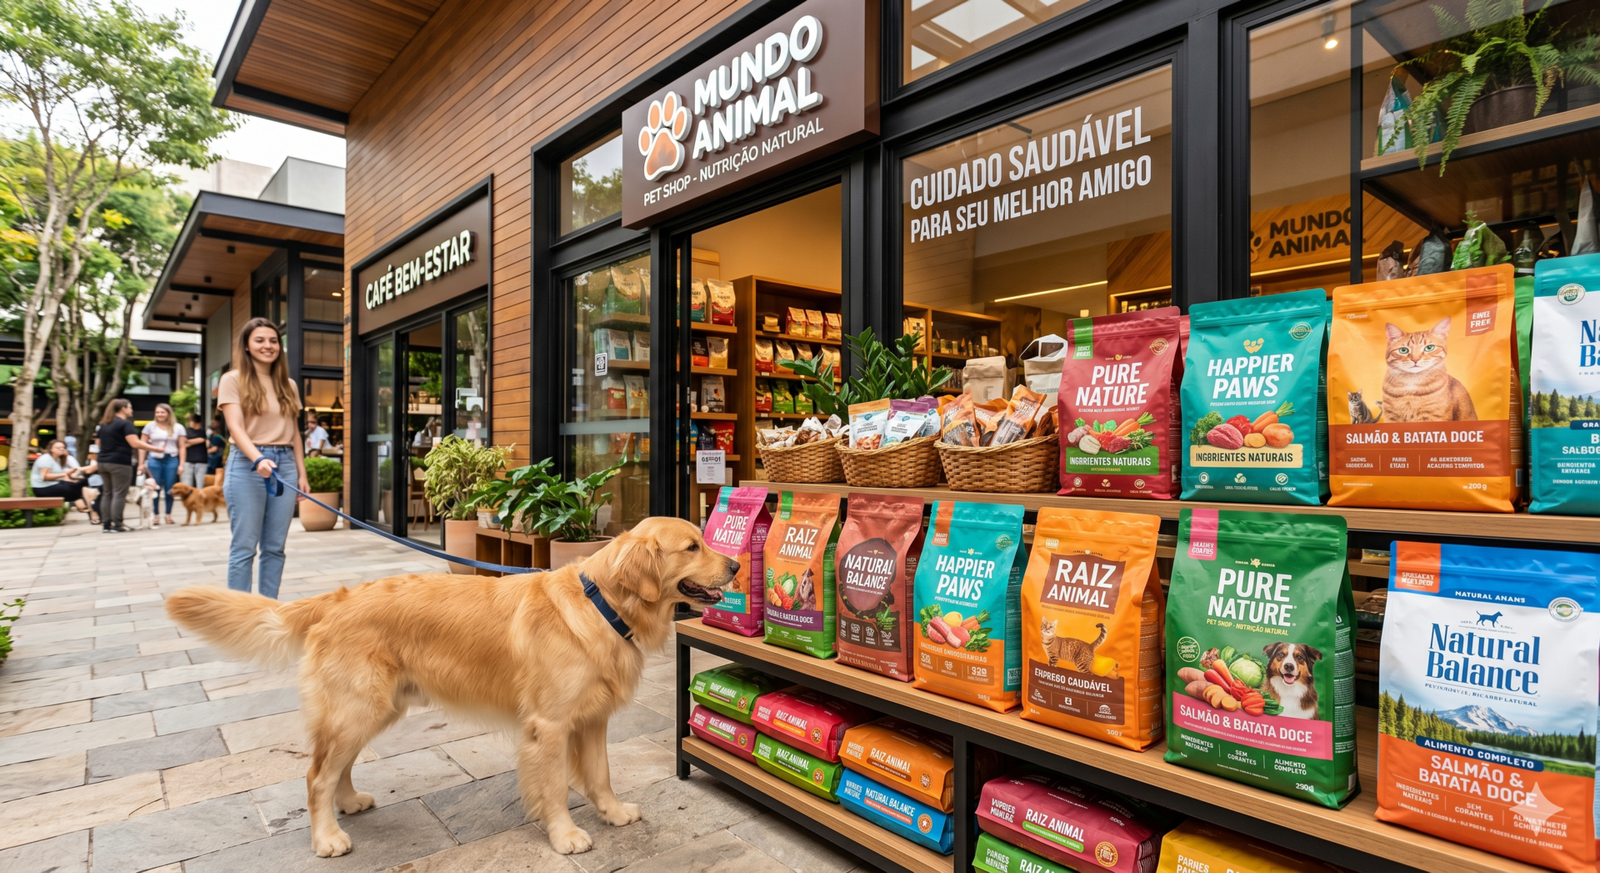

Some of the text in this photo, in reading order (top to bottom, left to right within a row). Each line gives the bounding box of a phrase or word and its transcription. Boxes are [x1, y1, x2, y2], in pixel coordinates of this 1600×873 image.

[695, 15, 823, 116] MUNDO
[692, 67, 823, 159] ANIMAL
[643, 187, 662, 207] PET
[662, 176, 691, 198] SHOP
[699, 145, 759, 183] NUTRIÇÃO
[761, 117, 824, 156] NATURAL
[910, 105, 1151, 210] CUIDADO SAUDÁVEL
[910, 154, 1152, 244] PARA SEU MELHOR AMIGO
[1269, 229, 1366, 258] ANIMA
[365, 229, 471, 310] CAFÉ BEM-ESTAR
[1091, 361, 1143, 385] PURE
[1207, 353, 1295, 377] HAPPIER
[1075, 382, 1150, 407] NATURE
[1212, 375, 1280, 400] PAWS
[1346, 429, 1484, 444] SALMÃO & BATATA DOCE
[1112, 457, 1152, 466] NATURAIS
[1248, 453, 1293, 463] NATURAIS
[722, 514, 749, 530] PURE
[784, 526, 819, 546] RAIZ
[778, 543, 813, 560] ANIMAL
[844, 553, 894, 575] NATURAL
[934, 554, 995, 579] HAPPIER
[1054, 558, 1117, 589] RAIZ
[846, 570, 888, 590] BALANCE
[936, 574, 984, 601] PAWS
[1217, 567, 1293, 602] PURE
[1046, 583, 1110, 608] ANIMAL
[1455, 590, 1493, 600] NATURAL
[799, 616, 814, 624] DOCE
[1207, 595, 1294, 627] NATURE
[1429, 622, 1541, 665] Natural
[1425, 649, 1539, 695] Balance
[1067, 677, 1113, 693] CAUDÁVEL
[1180, 704, 1220, 725] SALMÃO
[1222, 716, 1232, 729] &
[1233, 718, 1277, 738] BATATA
[1279, 727, 1313, 744] DOCE
[870, 747, 887, 762] RAIZ
[885, 754, 911, 773] ANIMAL
[1227, 753, 1257, 766] CORANTES
[1235, 749, 1248, 757] SEM
[1274, 758, 1306, 769] ALIMENTO
[1424, 739, 1535, 769] ALIMENTO COMPLETO
[1274, 764, 1307, 776] COMPLETO
[1430, 755, 1524, 788] SALMÃO &
[1419, 767, 1538, 808] BATATA DOCE
[888, 797, 916, 817] BALANCE
[1454, 806, 1494, 822] CORANTES
[1466, 802, 1482, 811] SEM
[1025, 808, 1085, 843] RAIZ ANIMAL
